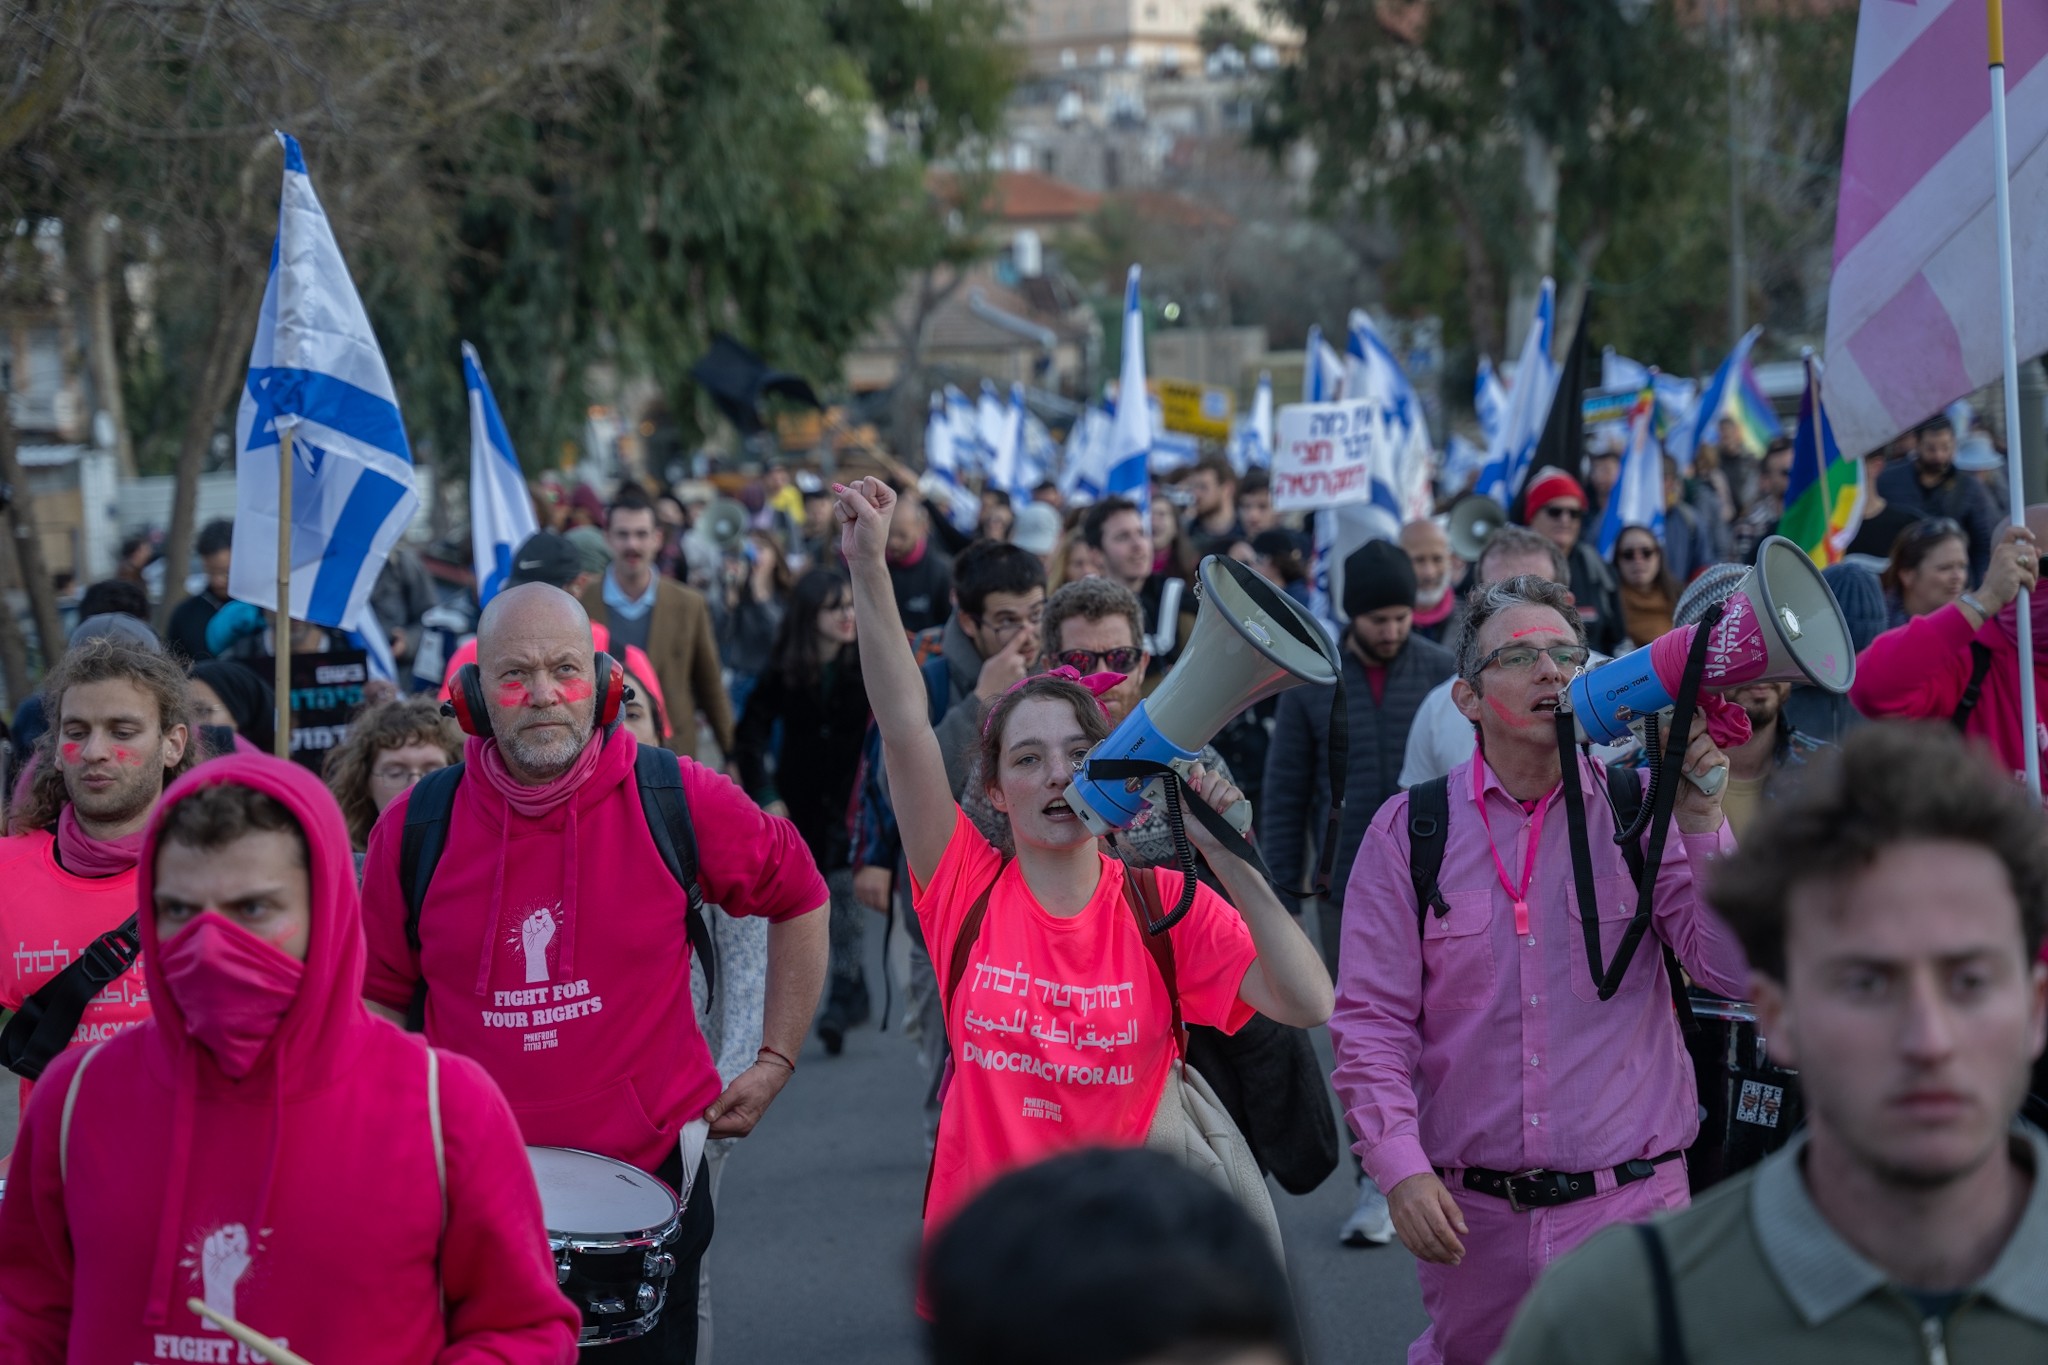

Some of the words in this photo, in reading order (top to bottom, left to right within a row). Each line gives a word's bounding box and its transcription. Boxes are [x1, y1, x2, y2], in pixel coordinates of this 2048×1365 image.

[1292, 439, 1334, 466] חצי
[1616, 685, 1629, 695] PRO
[1631, 674, 1649, 687] TONE
[1130, 736, 1146, 753] TONE
[13, 940, 70, 980] לכולן
[971, 954, 1030, 997] לכולן
[494, 987, 549, 1007] FIGHT
[552, 979, 590, 1001] FOR
[482, 1011, 529, 1028] YOUR
[532, 996, 603, 1027] RIGHTS
[964, 1009, 1028, 1038] للجميع
[1030, 1014, 1138, 1053] الديمقراطية
[963, 1041, 1067, 1083] DEMOCRACY
[1067, 1066, 1104, 1085] FOR
[1106, 1064, 1134, 1086] ALL
[154, 1334, 234, 1364] FIGHT
